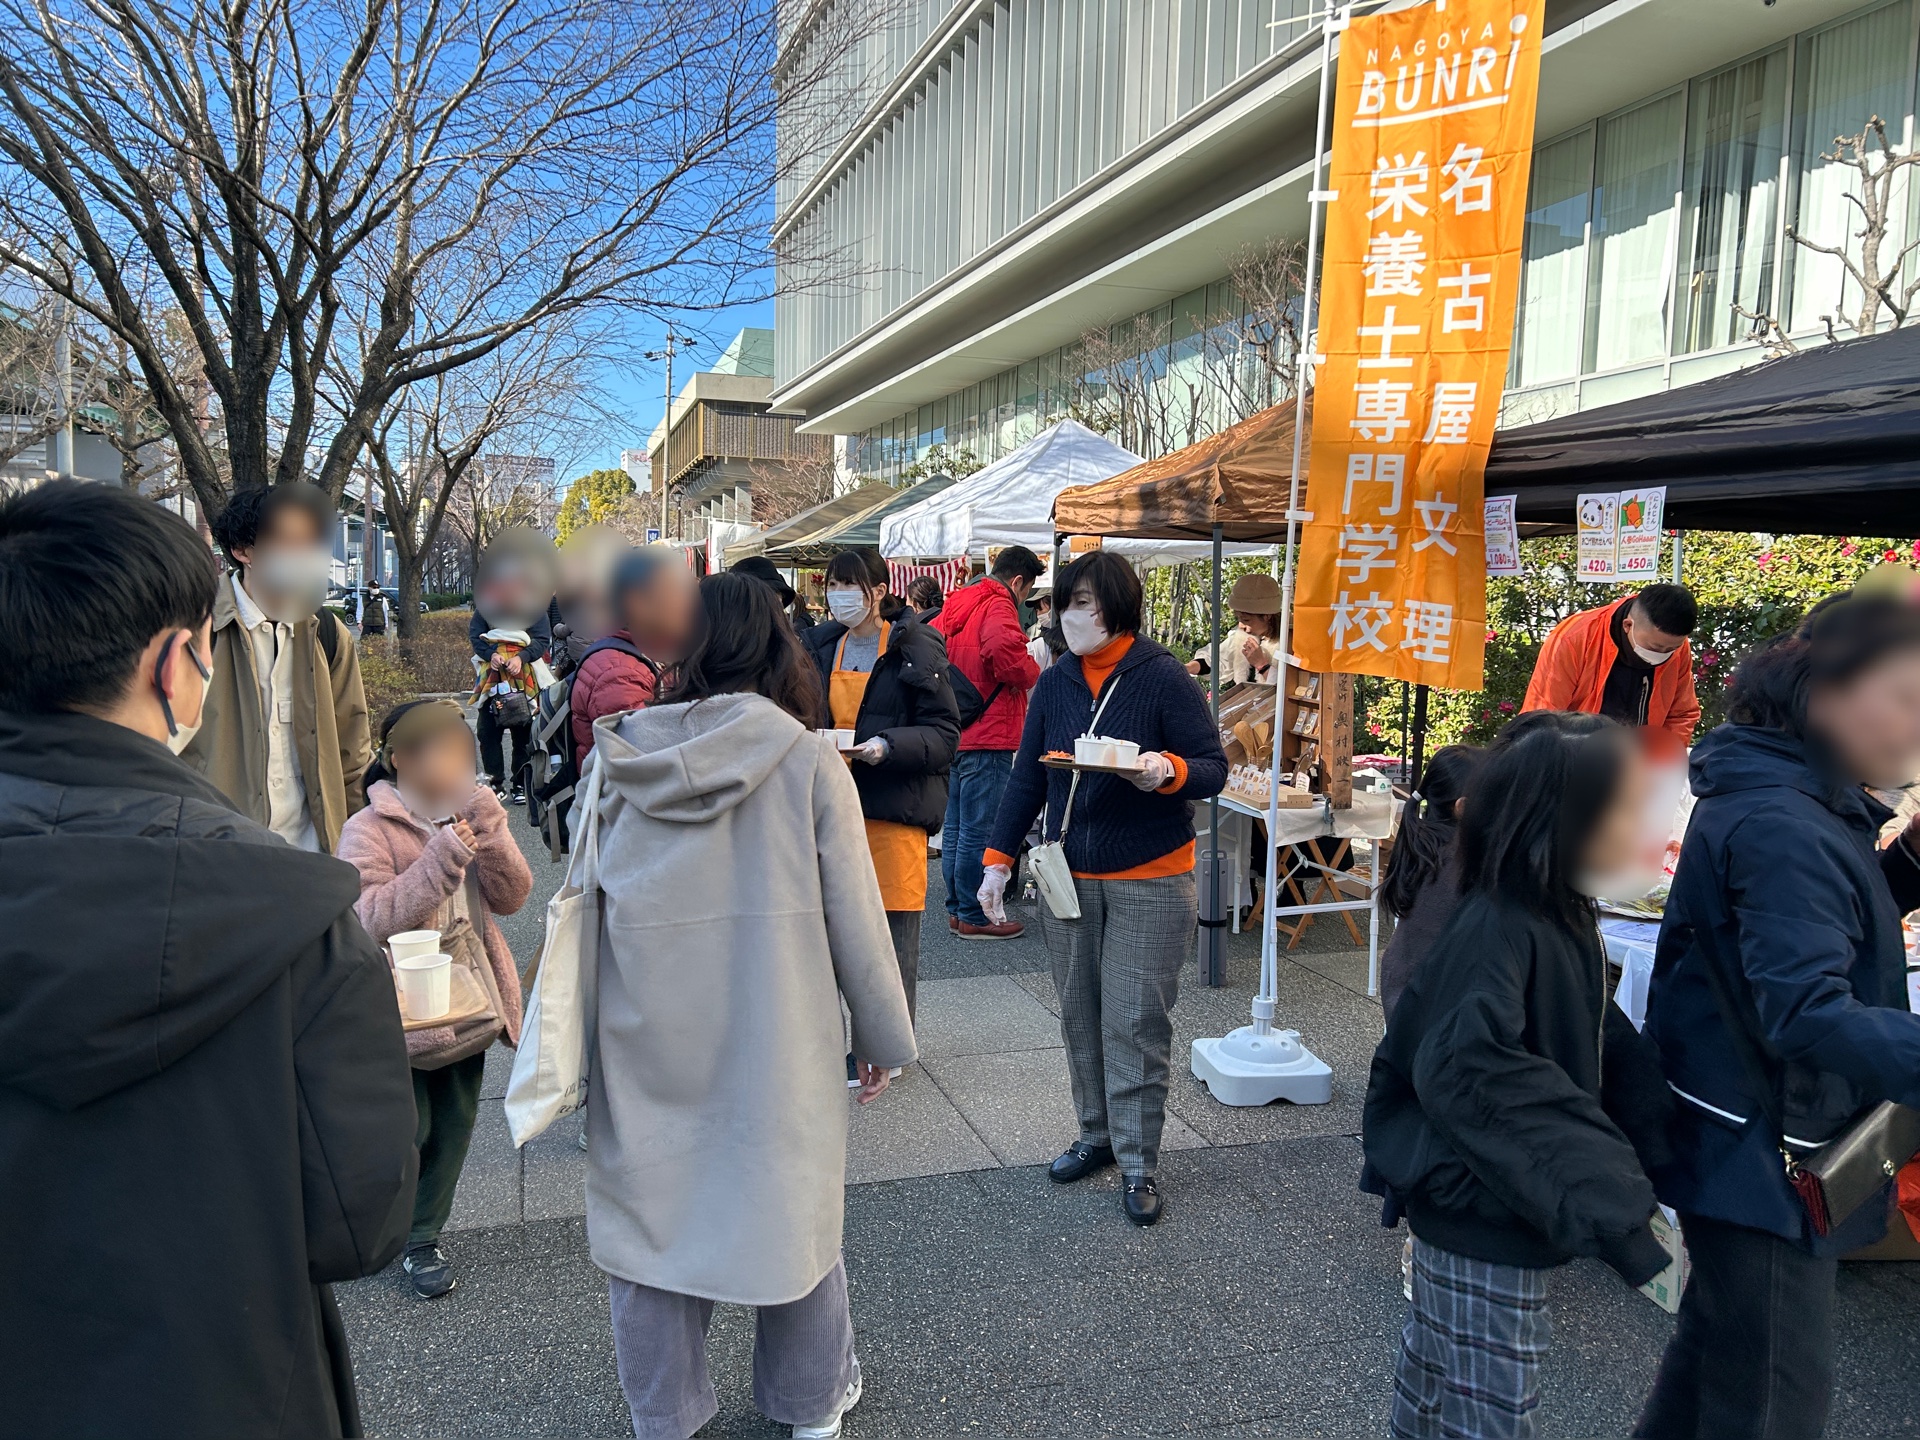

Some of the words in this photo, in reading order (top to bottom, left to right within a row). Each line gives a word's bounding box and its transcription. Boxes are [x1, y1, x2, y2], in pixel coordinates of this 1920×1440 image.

[1366, 22, 1494, 65] NAGOYA
[1328, 150, 1430, 653] 栄養士専門学校
[1399, 142, 1493, 664] 名古屋文理
